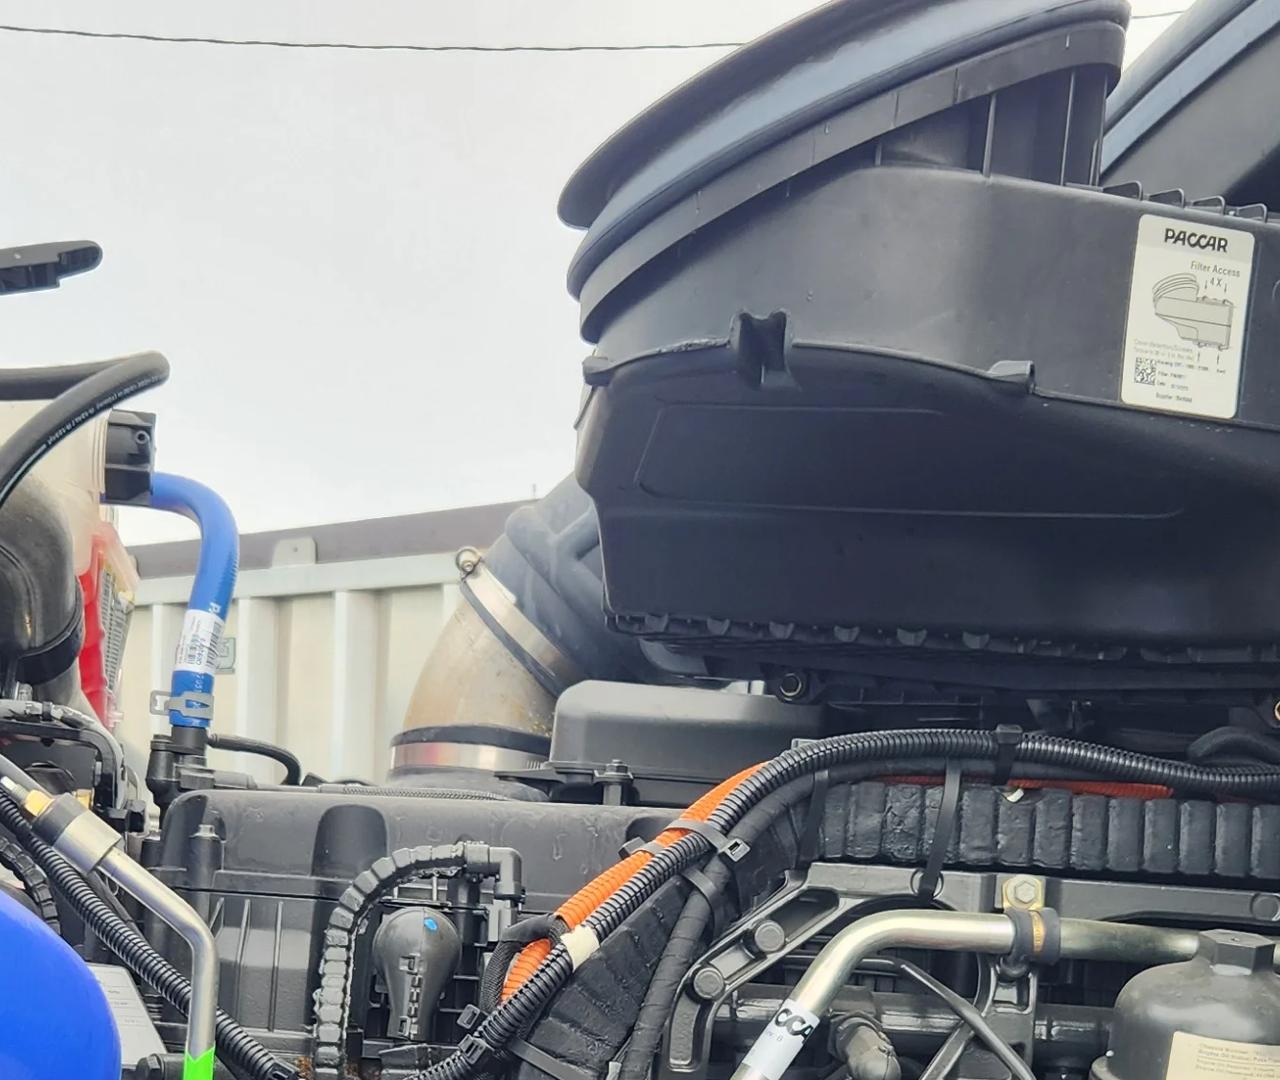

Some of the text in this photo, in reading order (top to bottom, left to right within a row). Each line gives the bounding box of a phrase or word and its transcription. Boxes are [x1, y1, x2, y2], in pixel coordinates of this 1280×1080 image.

[1163, 227, 1229, 253] PACCAR
[1190, 260, 1241, 278] Filter Access
